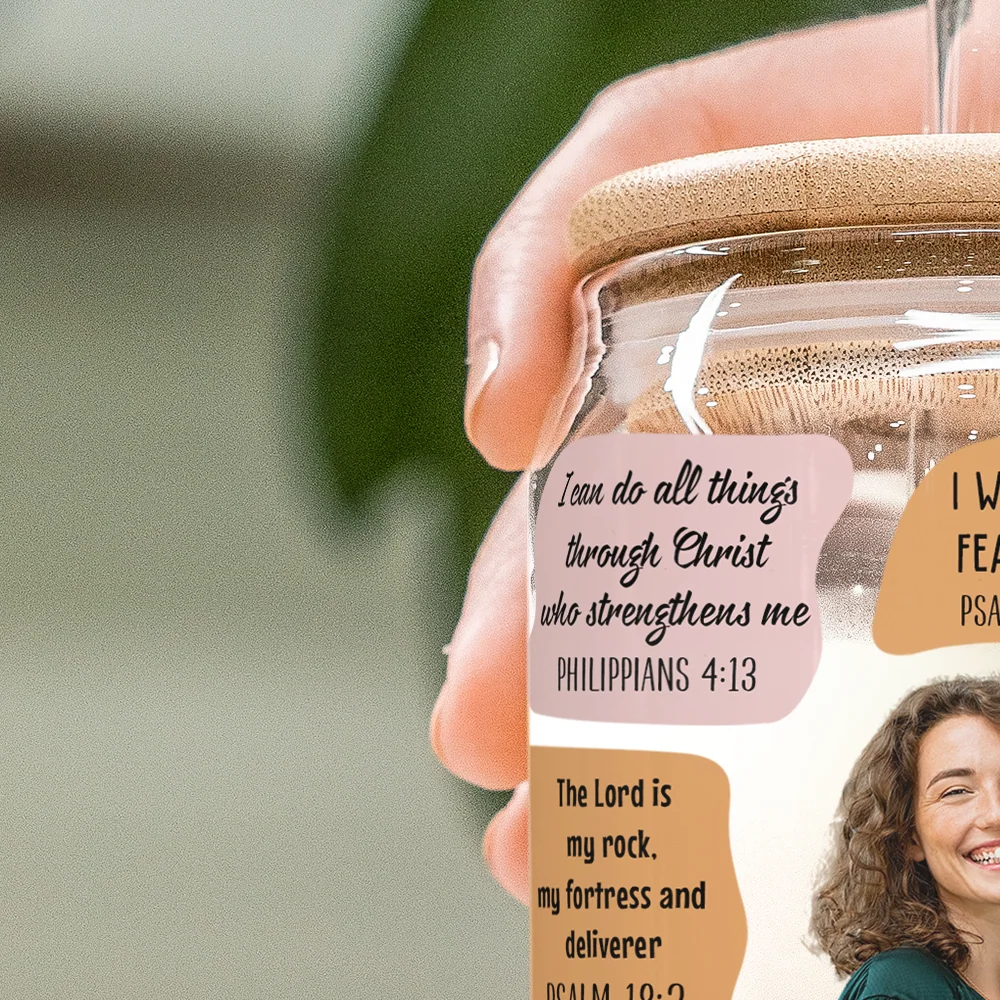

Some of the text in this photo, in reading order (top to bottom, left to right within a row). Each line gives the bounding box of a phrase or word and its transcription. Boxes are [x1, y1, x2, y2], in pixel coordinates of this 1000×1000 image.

[558, 458, 799, 525] I can do all things
[953, 471, 958, 510] I
[565, 526, 773, 589] through Christ
[540, 589, 811, 647] who strengthens me
[557, 656, 756, 692] PHILIPPIANS 4:13
[556, 777, 672, 808] The Lord is
[566, 829, 657, 865] my rock,
[537, 878, 706, 916] my fortress and
[565, 929, 662, 959] deliverer
